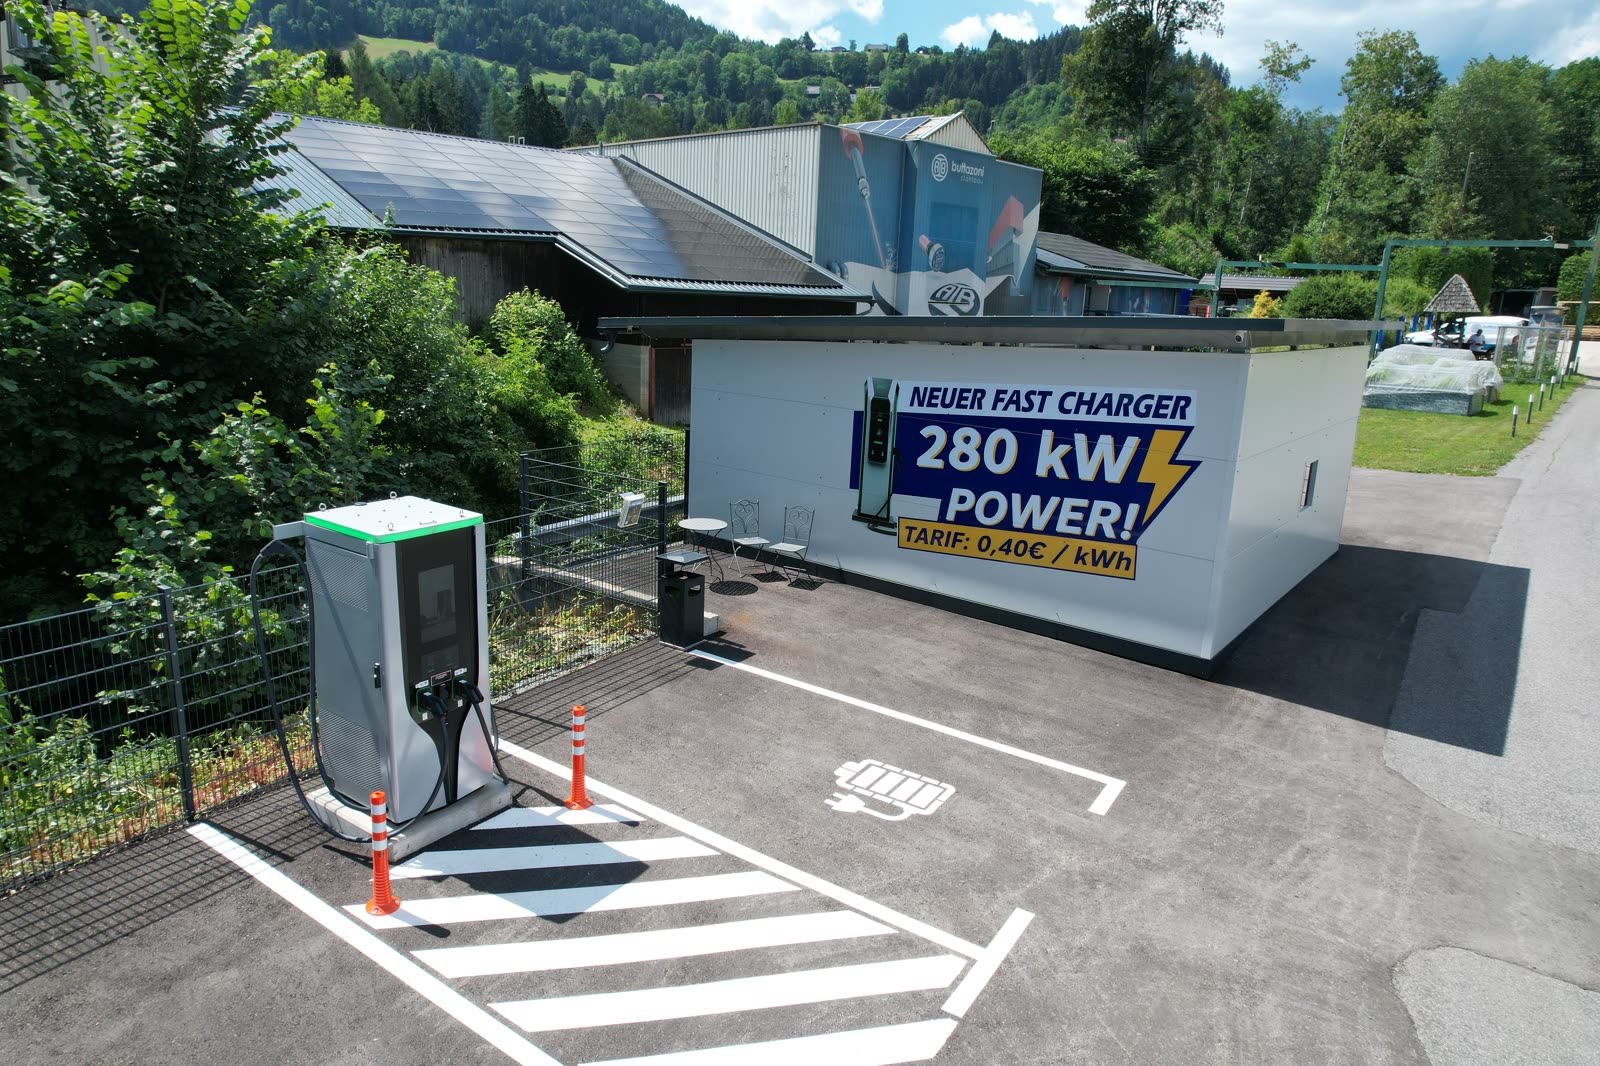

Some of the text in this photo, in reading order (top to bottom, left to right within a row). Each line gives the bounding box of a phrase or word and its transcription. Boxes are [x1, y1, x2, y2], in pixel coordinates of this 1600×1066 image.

[951, 160, 985, 177] buttazoni
[909, 386, 1192, 420] NEUER FAST CHARGER
[916, 425, 1141, 484] 280 kW
[945, 487, 1140, 541] POWER!
[904, 525, 1132, 571] TARIF: 0,40€ / kWh
